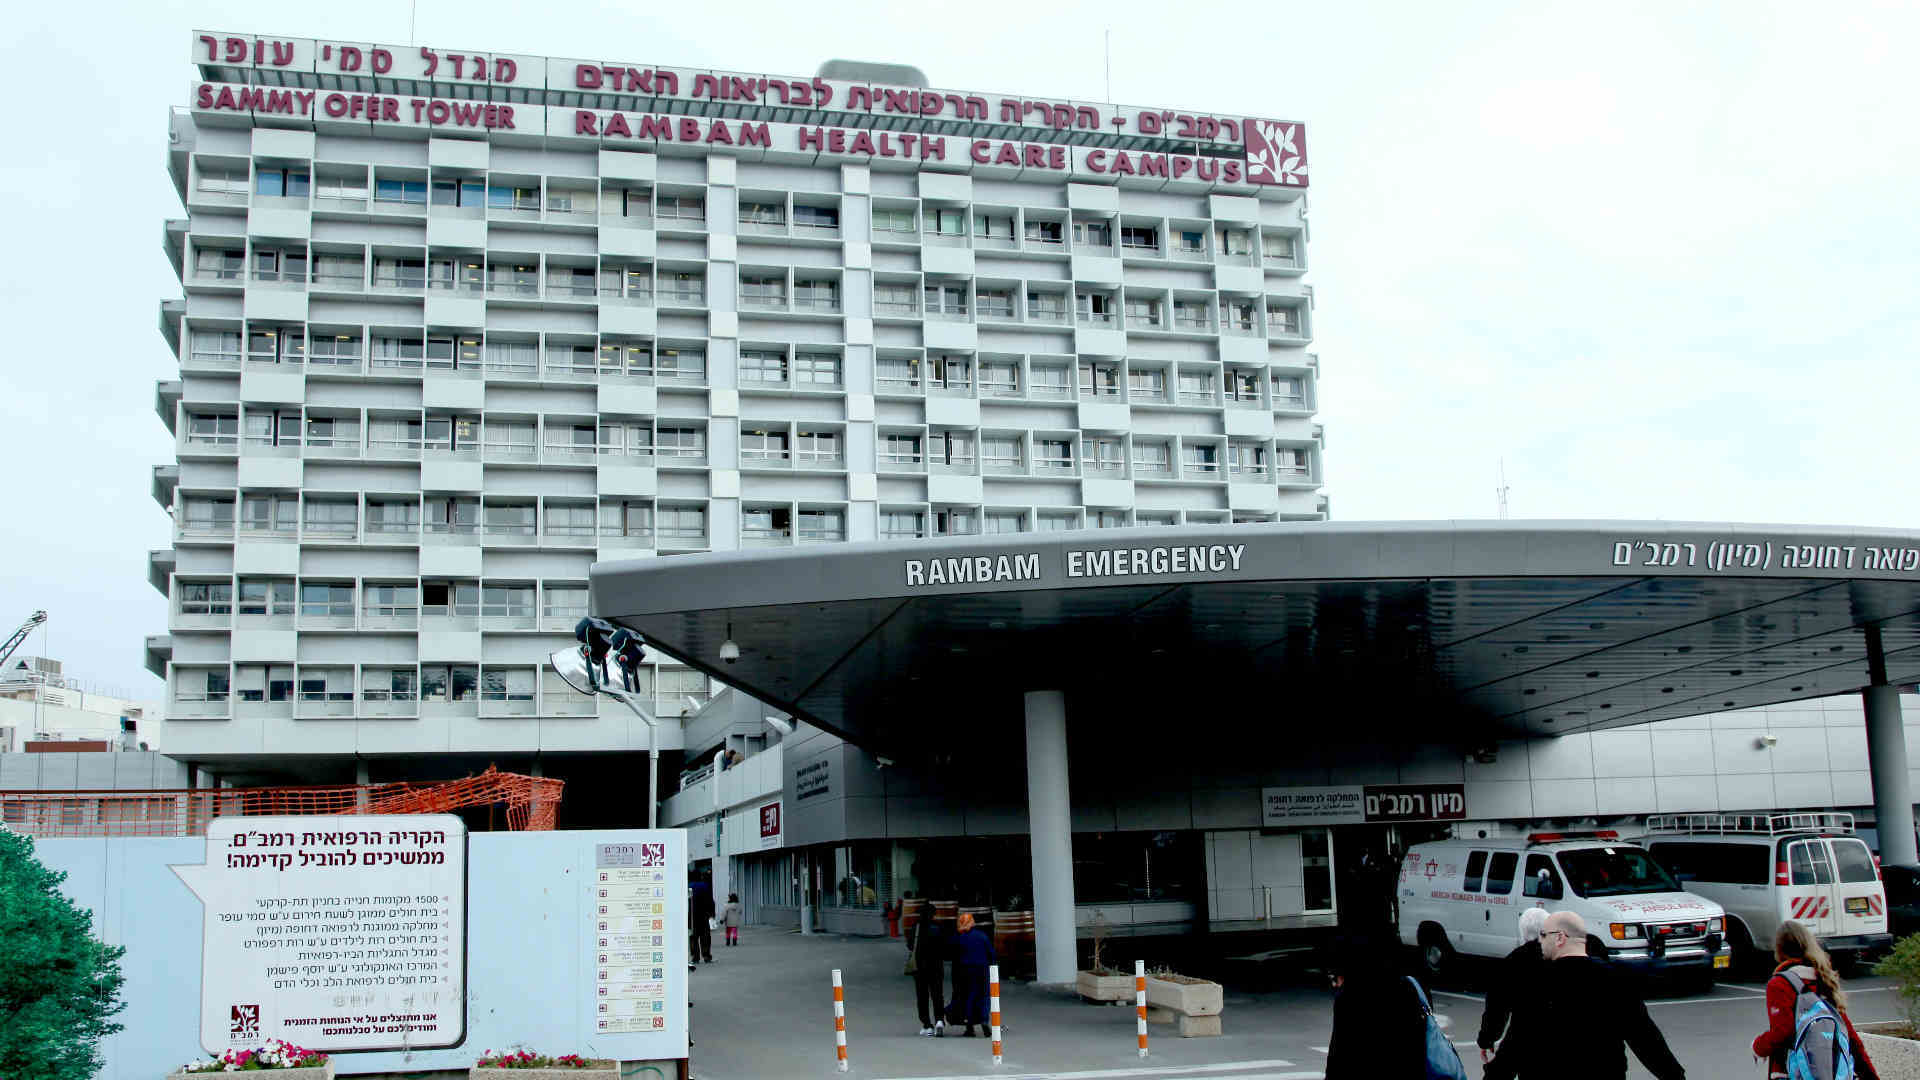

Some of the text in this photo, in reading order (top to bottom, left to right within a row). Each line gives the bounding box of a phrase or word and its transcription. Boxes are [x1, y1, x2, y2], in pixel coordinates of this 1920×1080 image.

[200, 35, 517, 83] מגדל סמי עופר
[576, 63, 679, 96] האדם
[692, 76, 833, 107] לבריאות
[197, 84, 515, 129] SAMMY OFER TOWER
[848, 86, 989, 120] הרפואית
[1001, 99, 1101, 131] הקריה
[1139, 111, 1239, 142] רמב"ם
[576, 110, 1245, 182] RAMBAM HEALTH CARE CAMPUS
[1613, 541, 1920, 571] פואה דחופה (מיון) רמב"ם
[906, 544, 1246, 586] RAMBAM EMERGENCY
[1430, 793, 1463, 818] מיון
[301, 831, 385, 847] הרפואית
[389, 831, 445, 848] הקריה
[227, 849, 445, 871] ממשיכים להוביל קדימה!
[344, 897, 370, 906] חנייה
[373, 895, 411, 909] מקומות
[217, 913, 243, 924] עופר
[357, 911, 386, 923] ממוגן
[389, 908, 421, 919] חולים
[423, 910, 438, 919] בית
[285, 926, 318, 935] דחופה
[321, 922, 359, 934] לרפואה
[402, 922, 438, 933] מחלקה
[329, 935, 365, 948] לילדים
[389, 934, 416, 947] חולים
[421, 936, 438, 946] בית
[412, 947, 438, 959] מגדל
[272, 979, 296, 990] הדם
[419, 975, 438, 985] בית
[283, 1018, 318, 1027] הזמנית
[320, 1016, 352, 1026] הנוחות
[353, 1016, 365, 1025] אי
[366, 1014, 379, 1024] על
[422, 1013, 437, 1022] אנו
[373, 1024, 386, 1034] על
